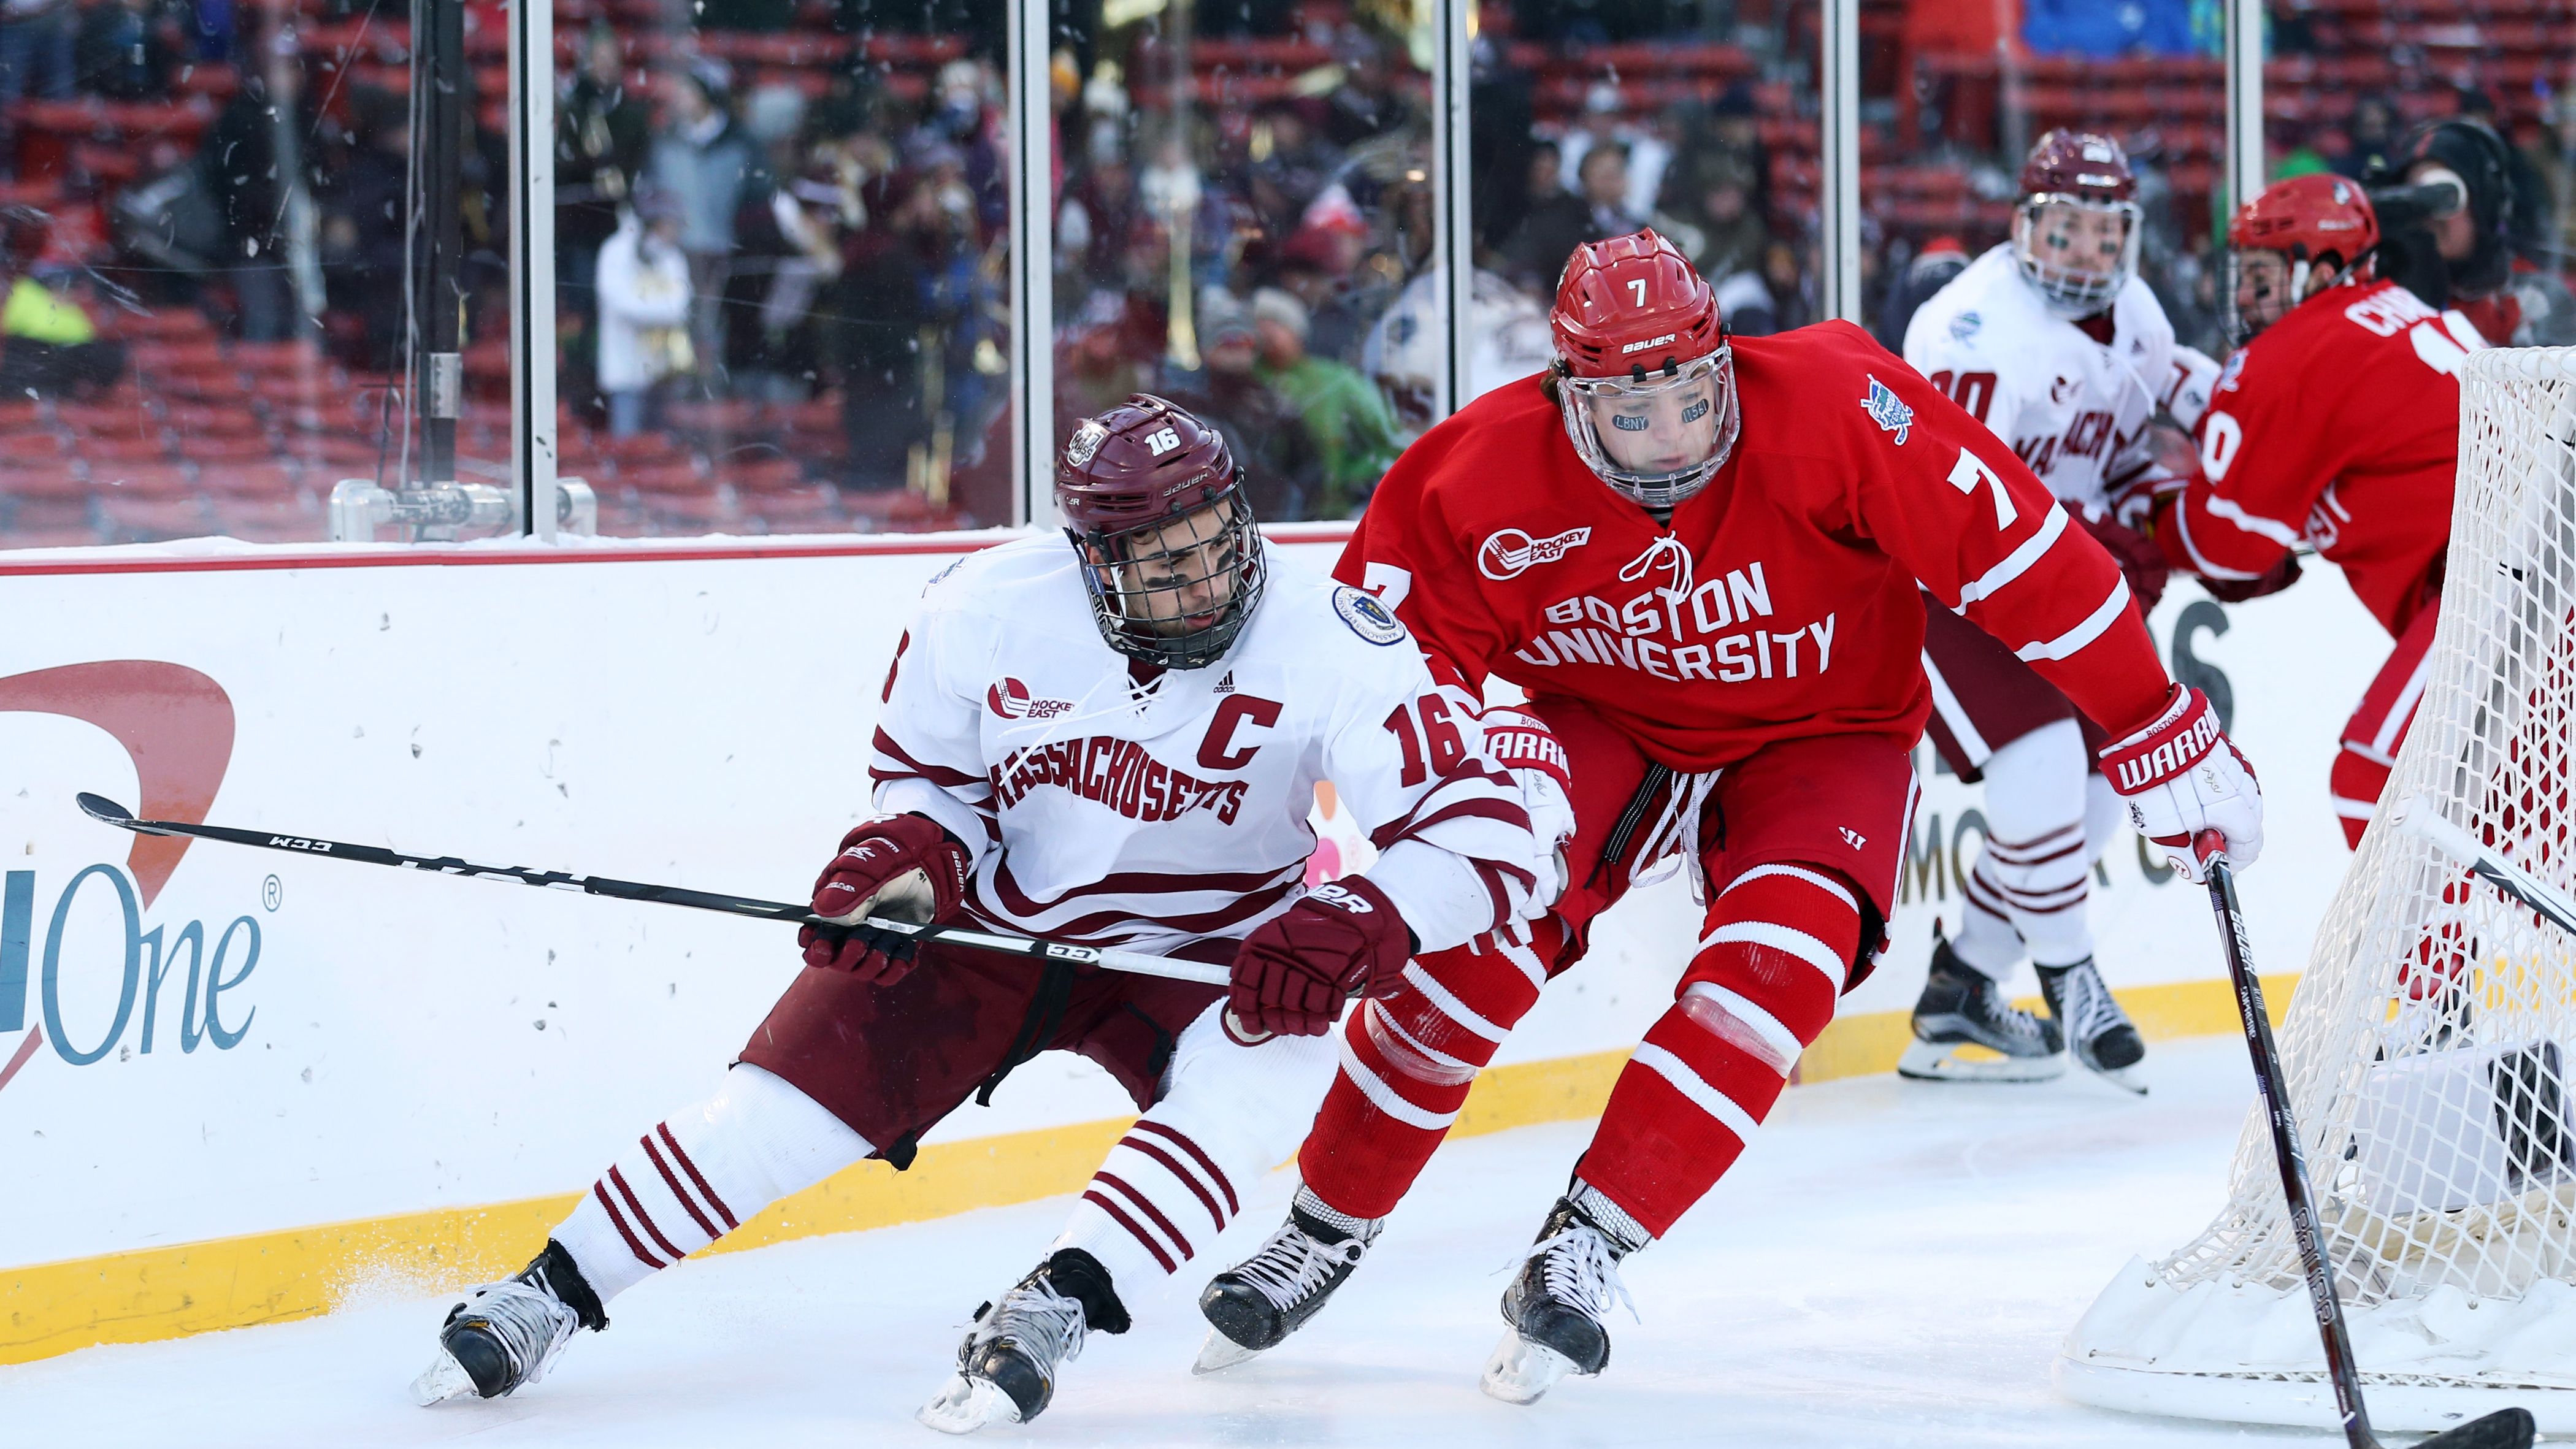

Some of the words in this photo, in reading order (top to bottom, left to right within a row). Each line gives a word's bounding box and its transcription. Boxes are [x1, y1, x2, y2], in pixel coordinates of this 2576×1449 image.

[1627, 278, 1647, 308] 7
[1622, 334, 1676, 354] BAUER
[1616, 416, 1646, 430] LBNY
[1144, 427, 1181, 457] 16
[1163, 472, 1209, 497] BAUER
[1947, 446, 2018, 532] 7
[1530, 547, 1563, 562] EAST
[1531, 531, 1585, 552] HOCKEY
[1544, 561, 1774, 643] BOSTON
[1514, 612, 1835, 683] UNIVERSITY
[1213, 684, 1236, 693] adidas
[1027, 709, 1059, 719] EAST
[1030, 700, 1075, 711] HOCKE
[1196, 694, 1284, 771] C
[2146, 712, 2179, 738] BOSTON
[1384, 693, 1467, 789] 16
[986, 735, 1250, 827] MASSACHUSETTS
[269, 836, 333, 852] CCM
[951, 850, 964, 893] BAUER
[2229, 909, 2258, 976] BAUER
[2292, 1207, 2336, 1325] BAUER
